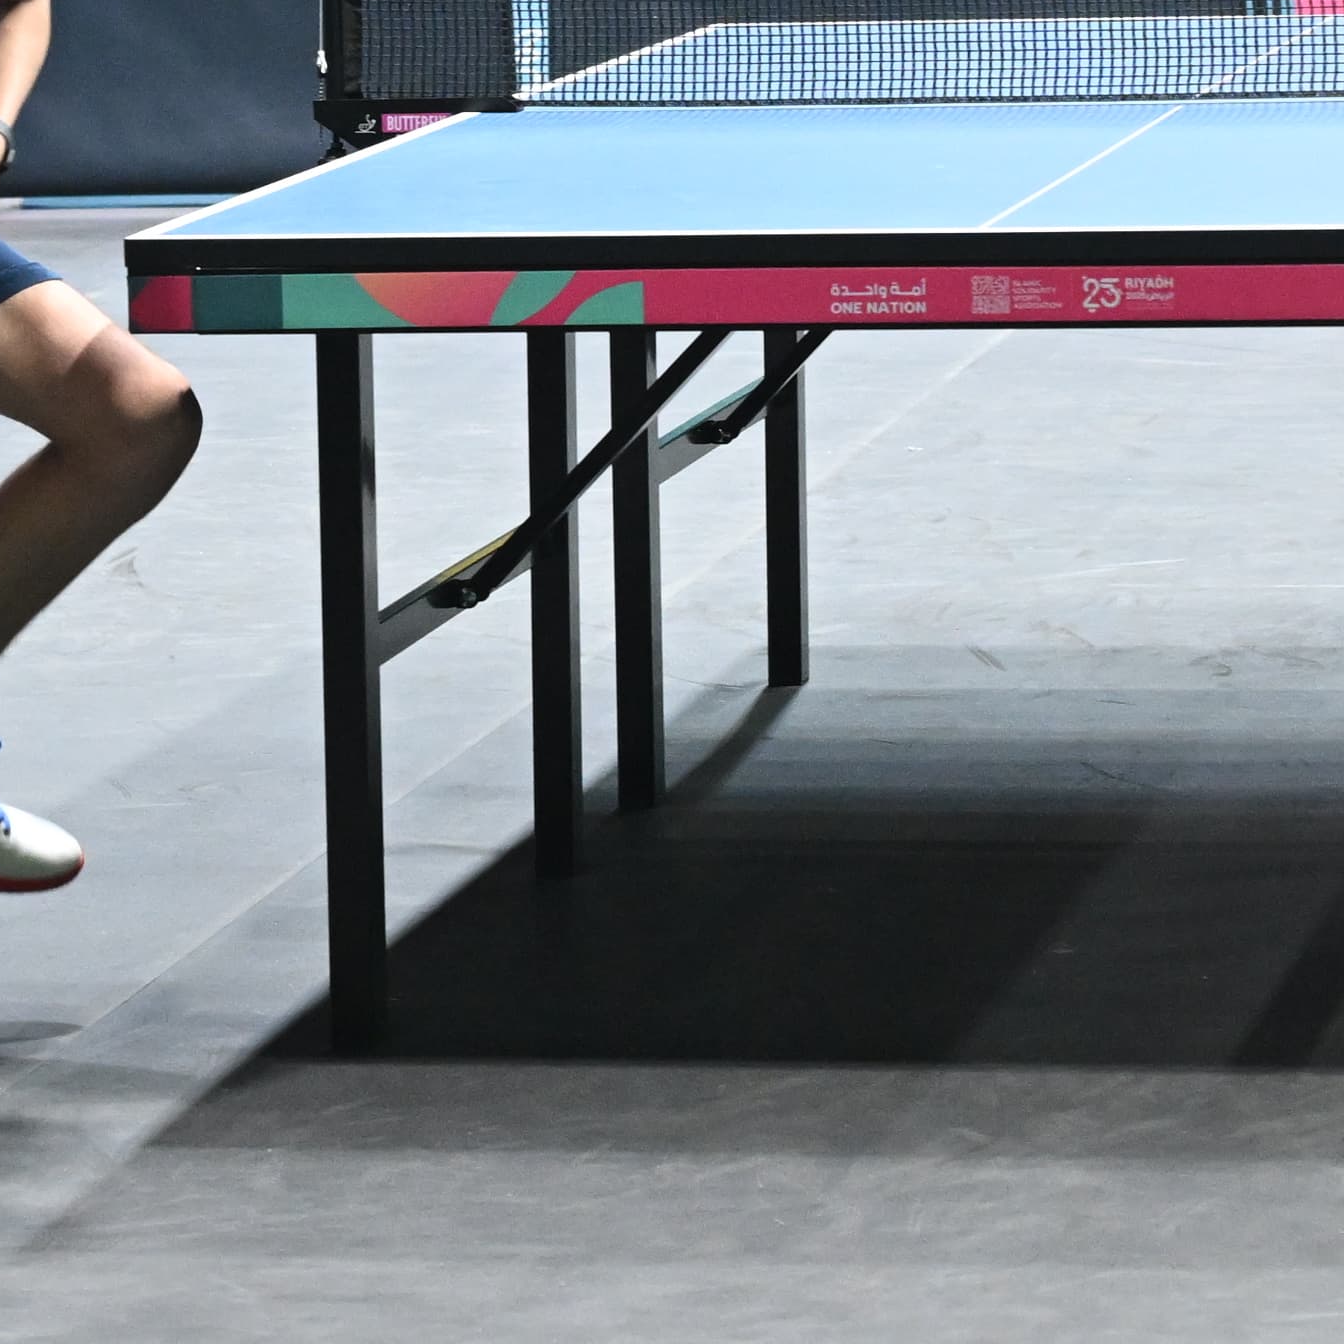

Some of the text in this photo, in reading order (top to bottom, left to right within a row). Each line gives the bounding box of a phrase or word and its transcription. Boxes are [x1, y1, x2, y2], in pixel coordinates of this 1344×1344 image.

[1125, 275, 1174, 290] RIYADH
[1082, 276, 1122, 312] 25
[830, 301, 927, 314] ONE NATION
